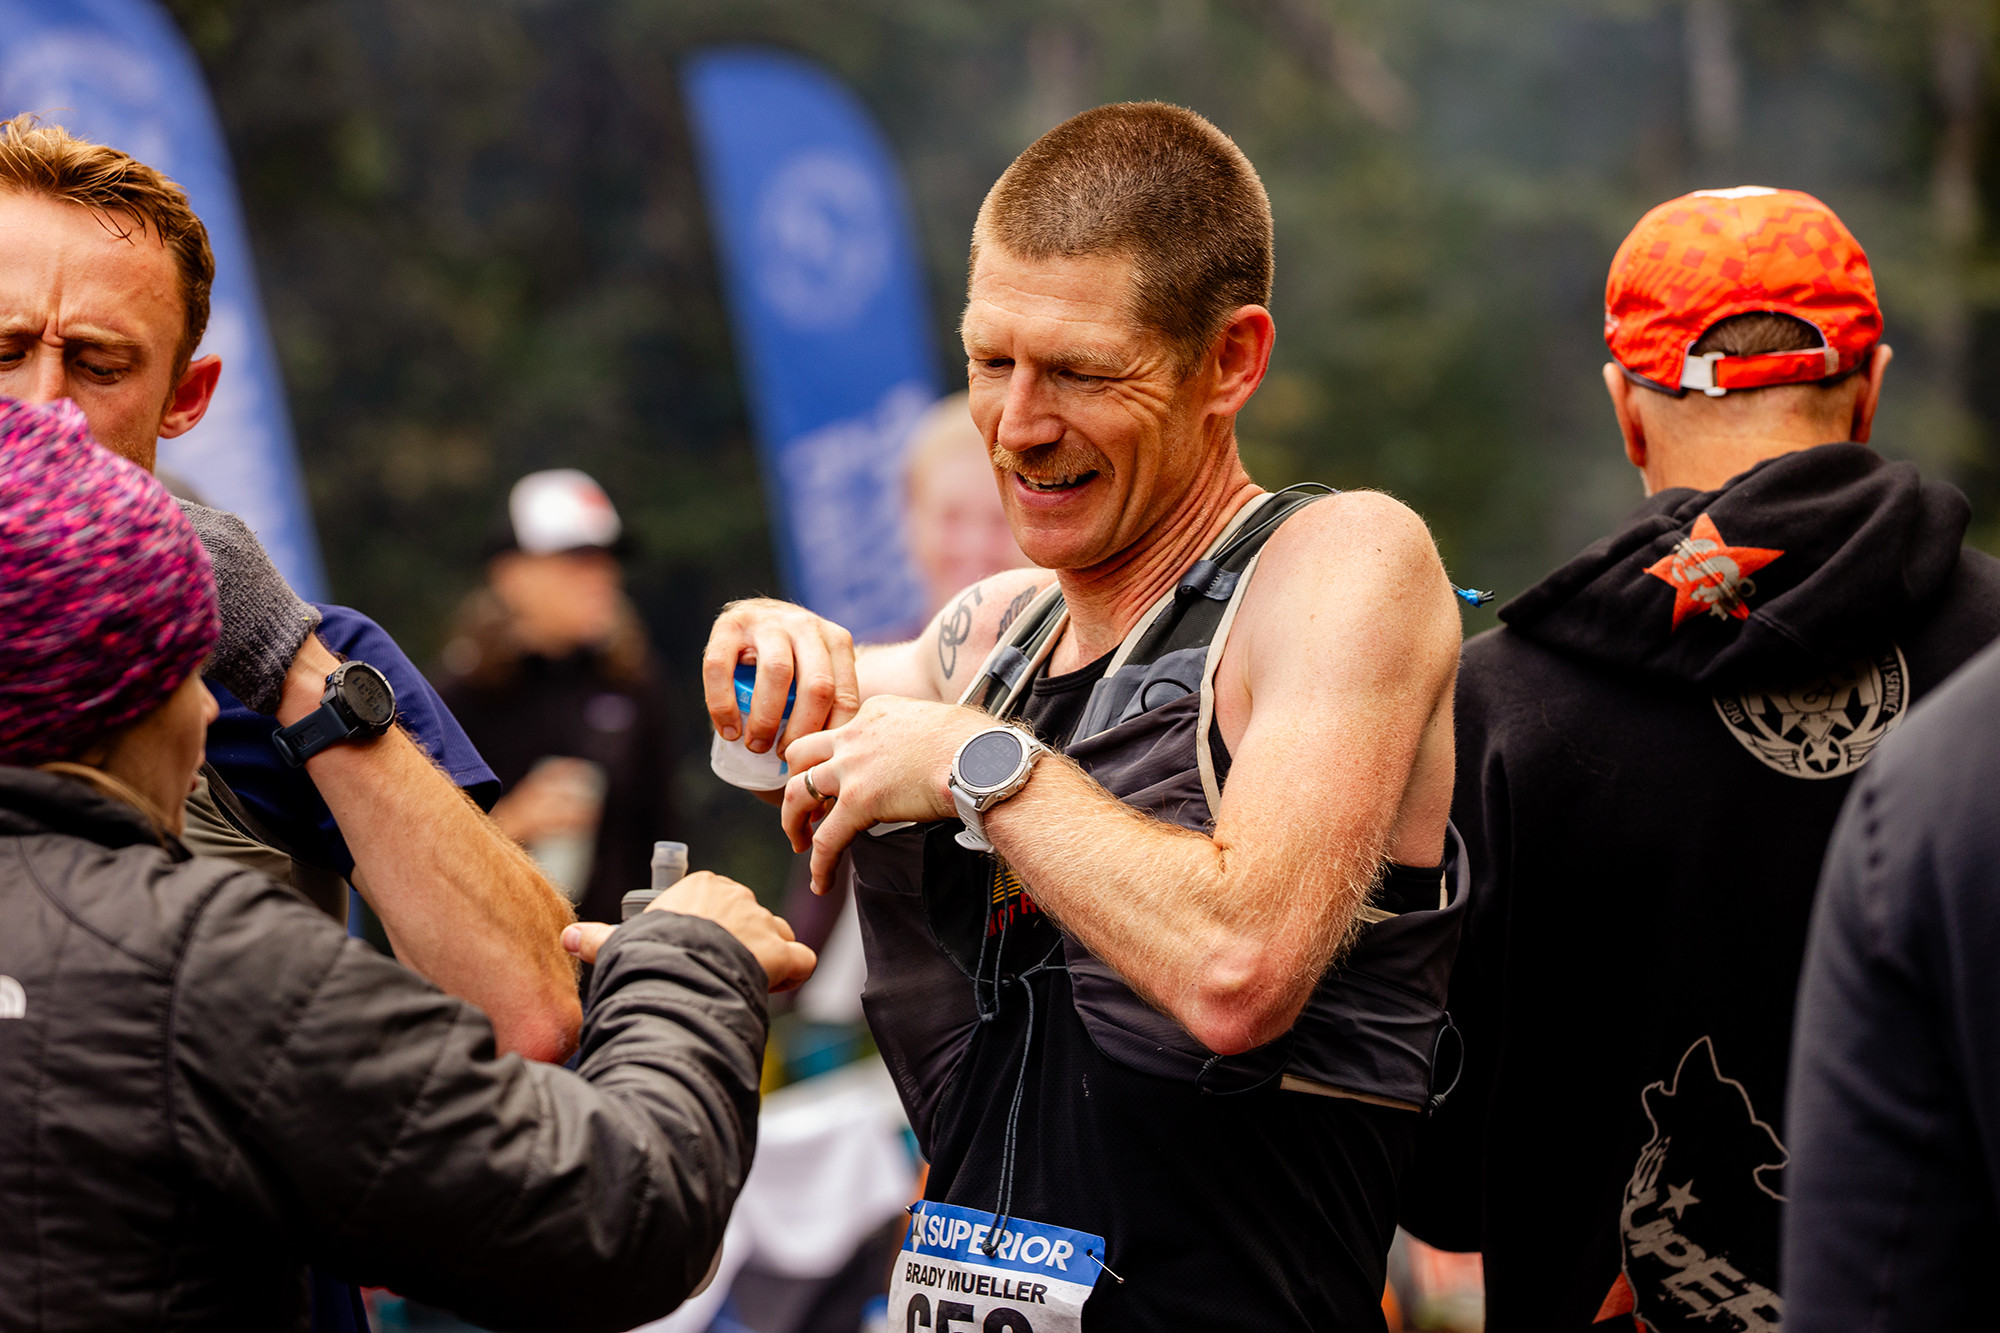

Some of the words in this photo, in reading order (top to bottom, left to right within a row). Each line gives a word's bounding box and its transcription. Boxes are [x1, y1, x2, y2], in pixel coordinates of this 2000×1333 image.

[927, 1214, 1075, 1272] SUPERIOR
[905, 1262, 946, 1290] BRADY
[947, 1270, 1048, 1304] MUELLER
